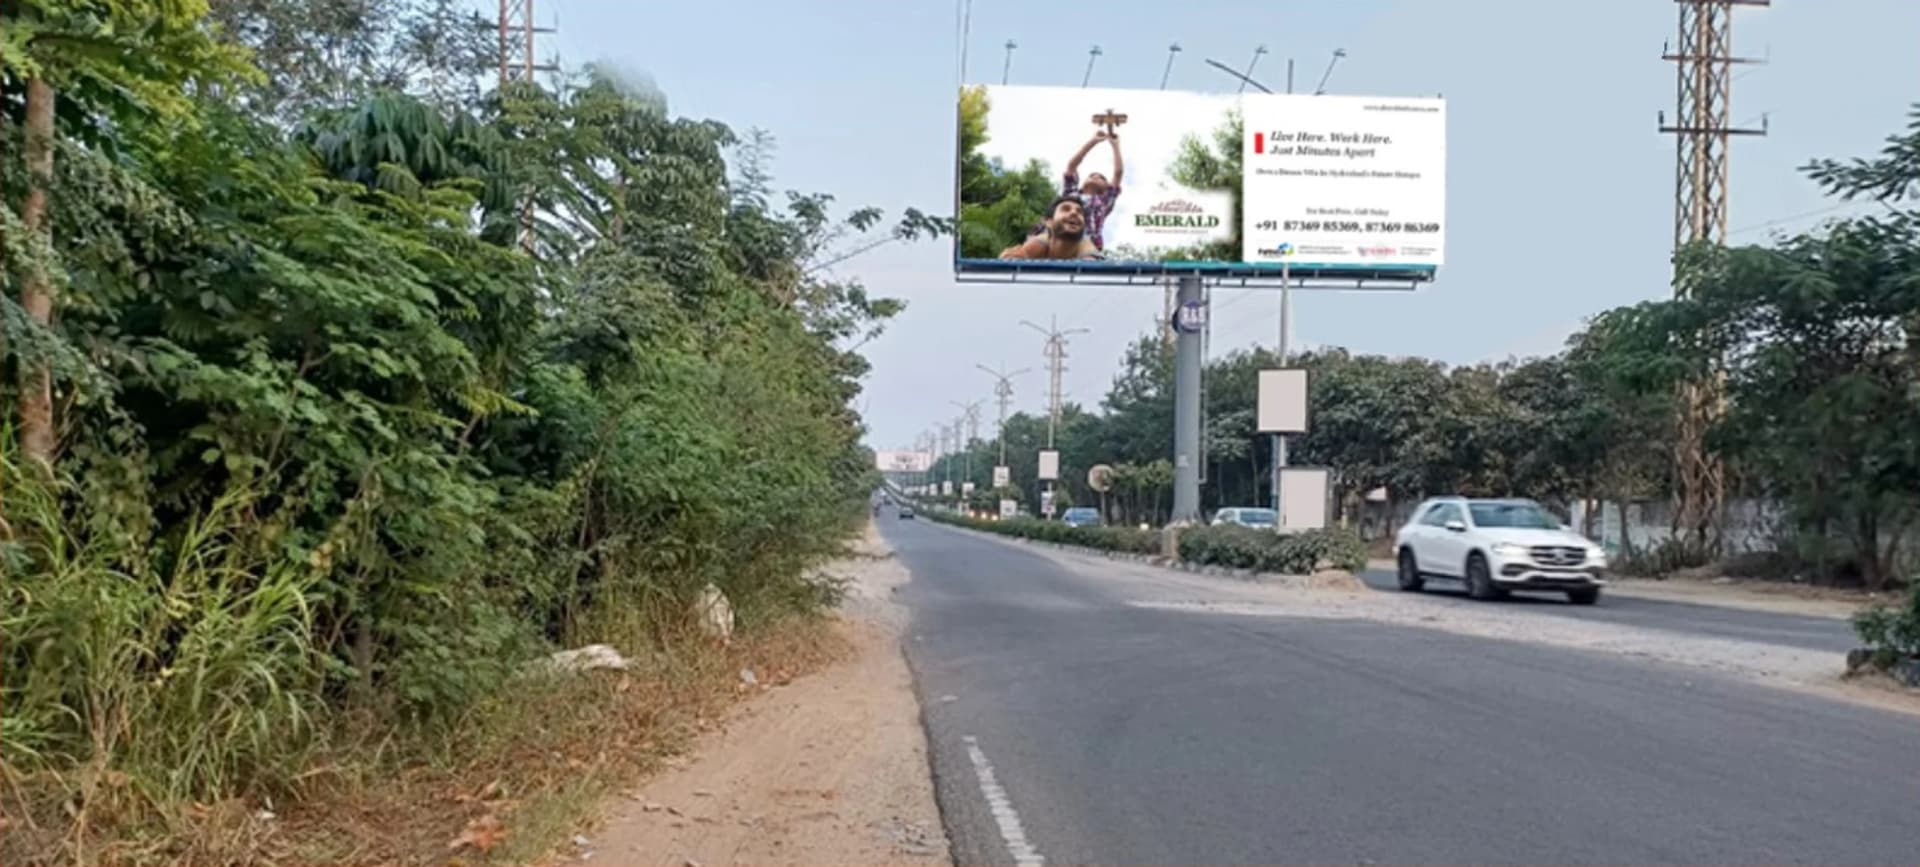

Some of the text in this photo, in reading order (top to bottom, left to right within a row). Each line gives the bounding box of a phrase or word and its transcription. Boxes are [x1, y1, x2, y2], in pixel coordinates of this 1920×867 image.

[1270, 131, 1393, 145] Live Here. Work Here.
[1269, 145, 1376, 159] Just Minutes Apart
[1135, 214, 1219, 228] EMERALD
[1256, 220, 1277, 231] +91
[1283, 220, 1320, 232] 87369
[1365, 222, 1401, 233] 87369
